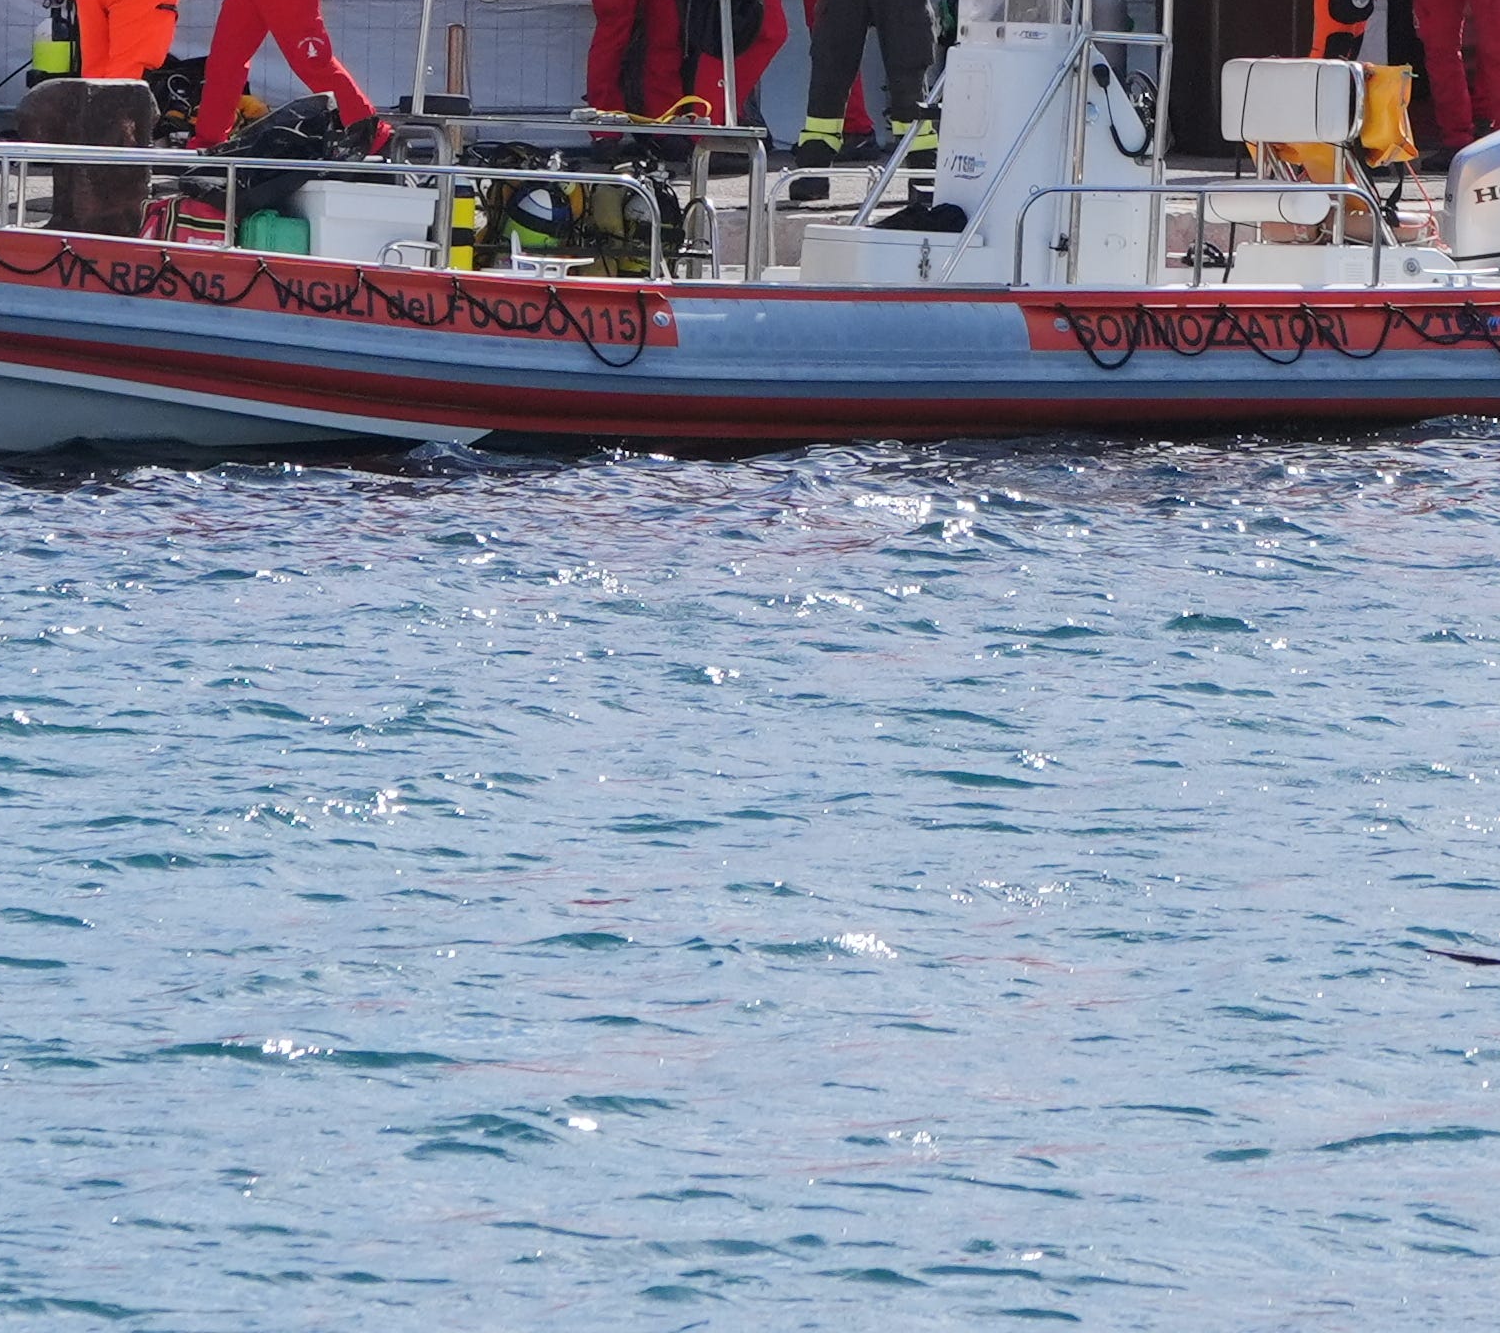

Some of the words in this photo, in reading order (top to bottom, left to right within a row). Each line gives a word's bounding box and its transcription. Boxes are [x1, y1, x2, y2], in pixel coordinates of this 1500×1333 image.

[56, 256, 99, 288] VF
[108, 261, 179, 297] RBS
[190, 270, 226, 301] 05
[272, 277, 374, 318] VIGILI
[447, 294, 571, 337] FUOCO
[581, 305, 637, 341] 115
[1078, 311, 1350, 348] SOMMOZZATORI
